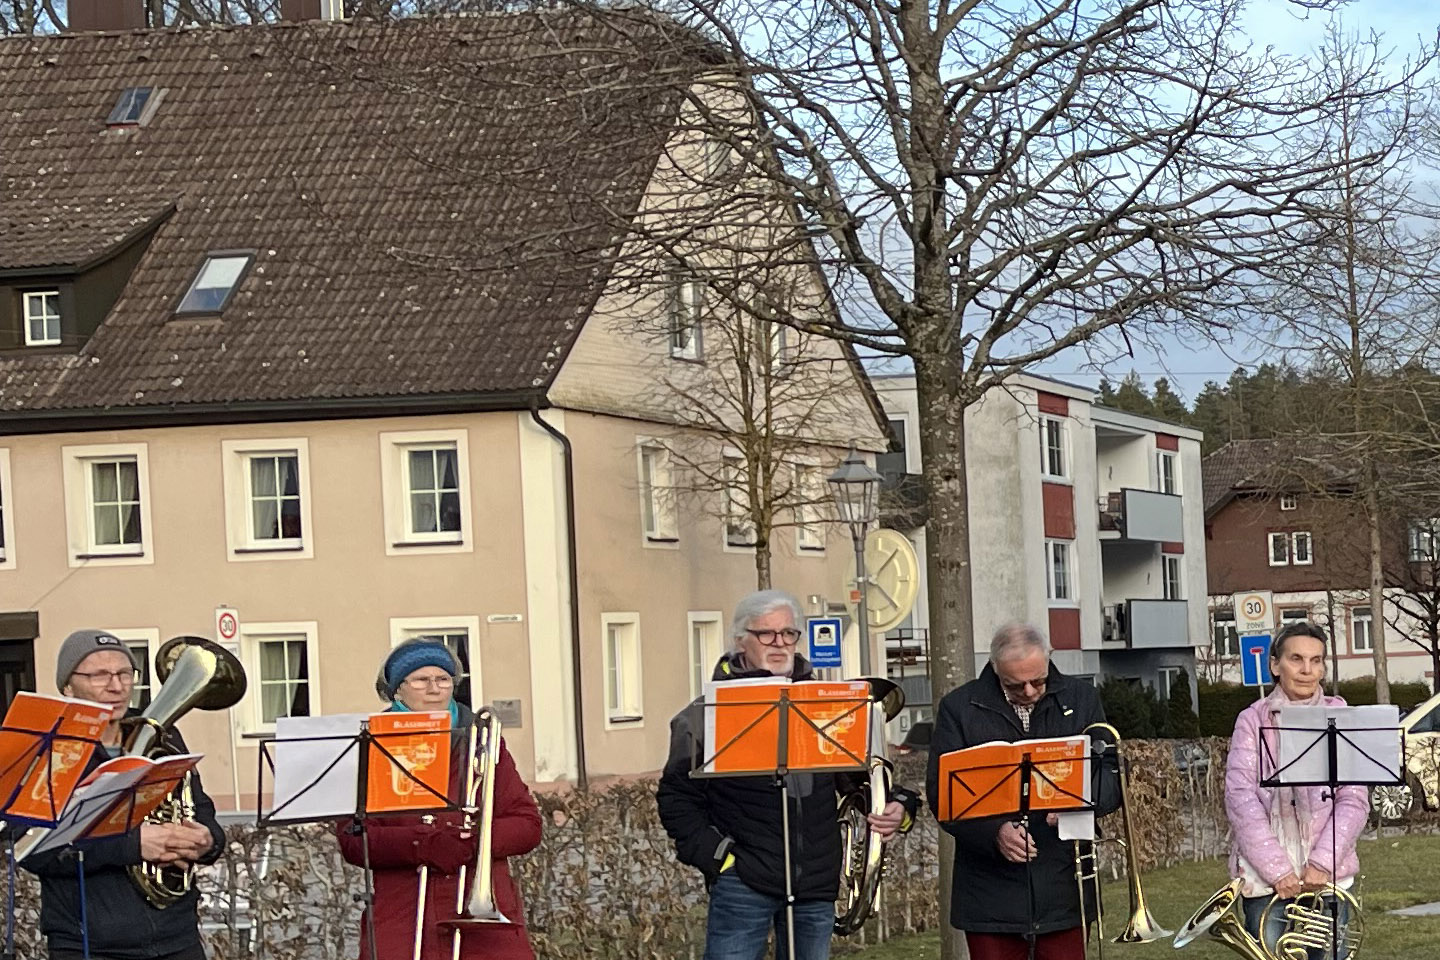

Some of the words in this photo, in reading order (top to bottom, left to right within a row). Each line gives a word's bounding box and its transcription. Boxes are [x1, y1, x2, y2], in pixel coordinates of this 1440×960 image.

[1246, 601, 1262, 615] 30
[222, 619, 233, 632] 30
[1246, 621, 1265, 630] ZONE
